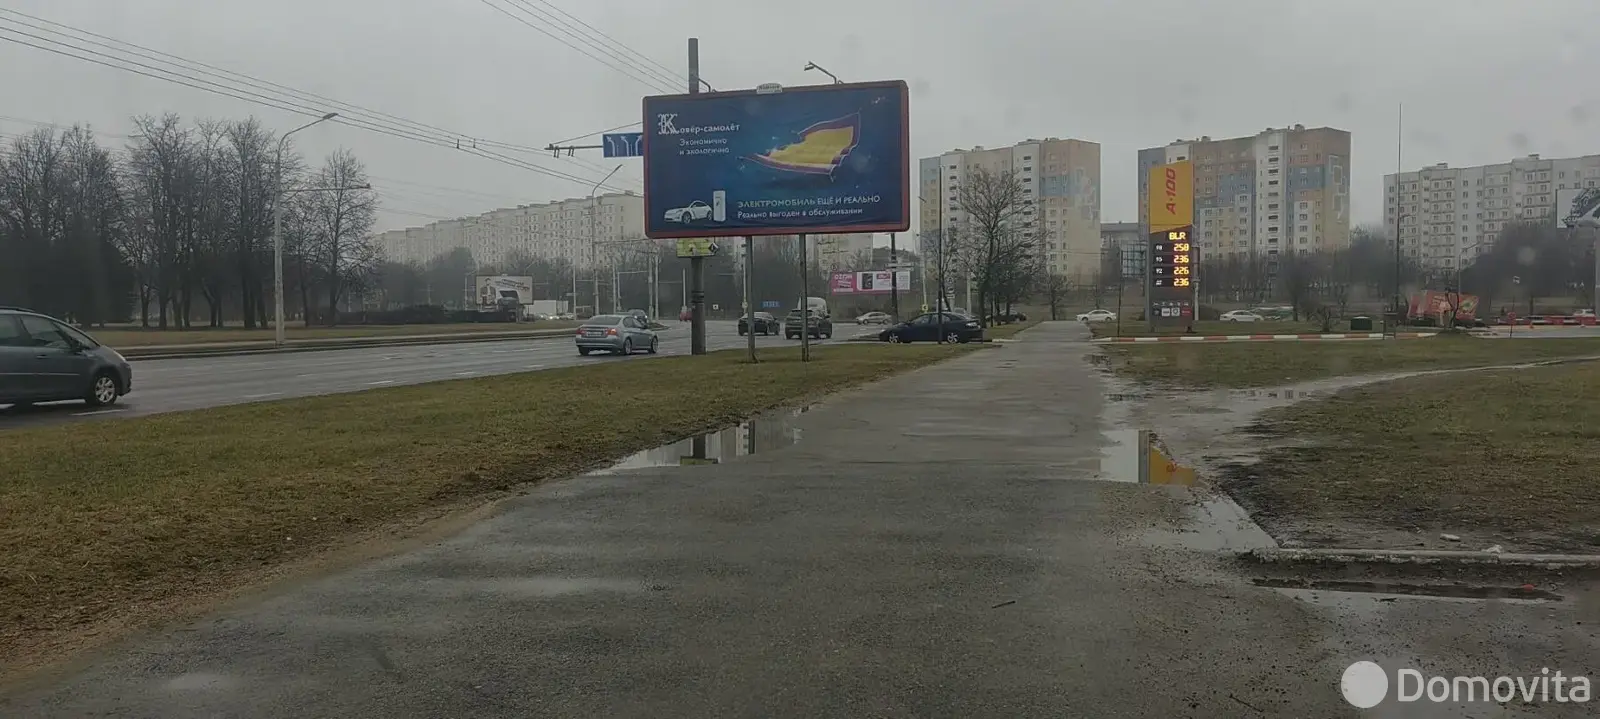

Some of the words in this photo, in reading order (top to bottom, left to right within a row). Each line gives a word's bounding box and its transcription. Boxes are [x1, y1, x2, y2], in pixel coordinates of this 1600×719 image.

[680, 138, 727, 146] Экономично
[738, 199, 816, 208] ЭЛЕКТРОМОБИЛЬ
[844, 195, 880, 203] РЕАЛЬНО
[737, 211, 768, 219] Реально
[808, 208, 862, 217] обслуживании
[1169, 232, 1186, 240] BLR
[1174, 255, 1189, 264] 236
[1174, 266, 1189, 275] 226
[1174, 278, 1189, 287] 236
